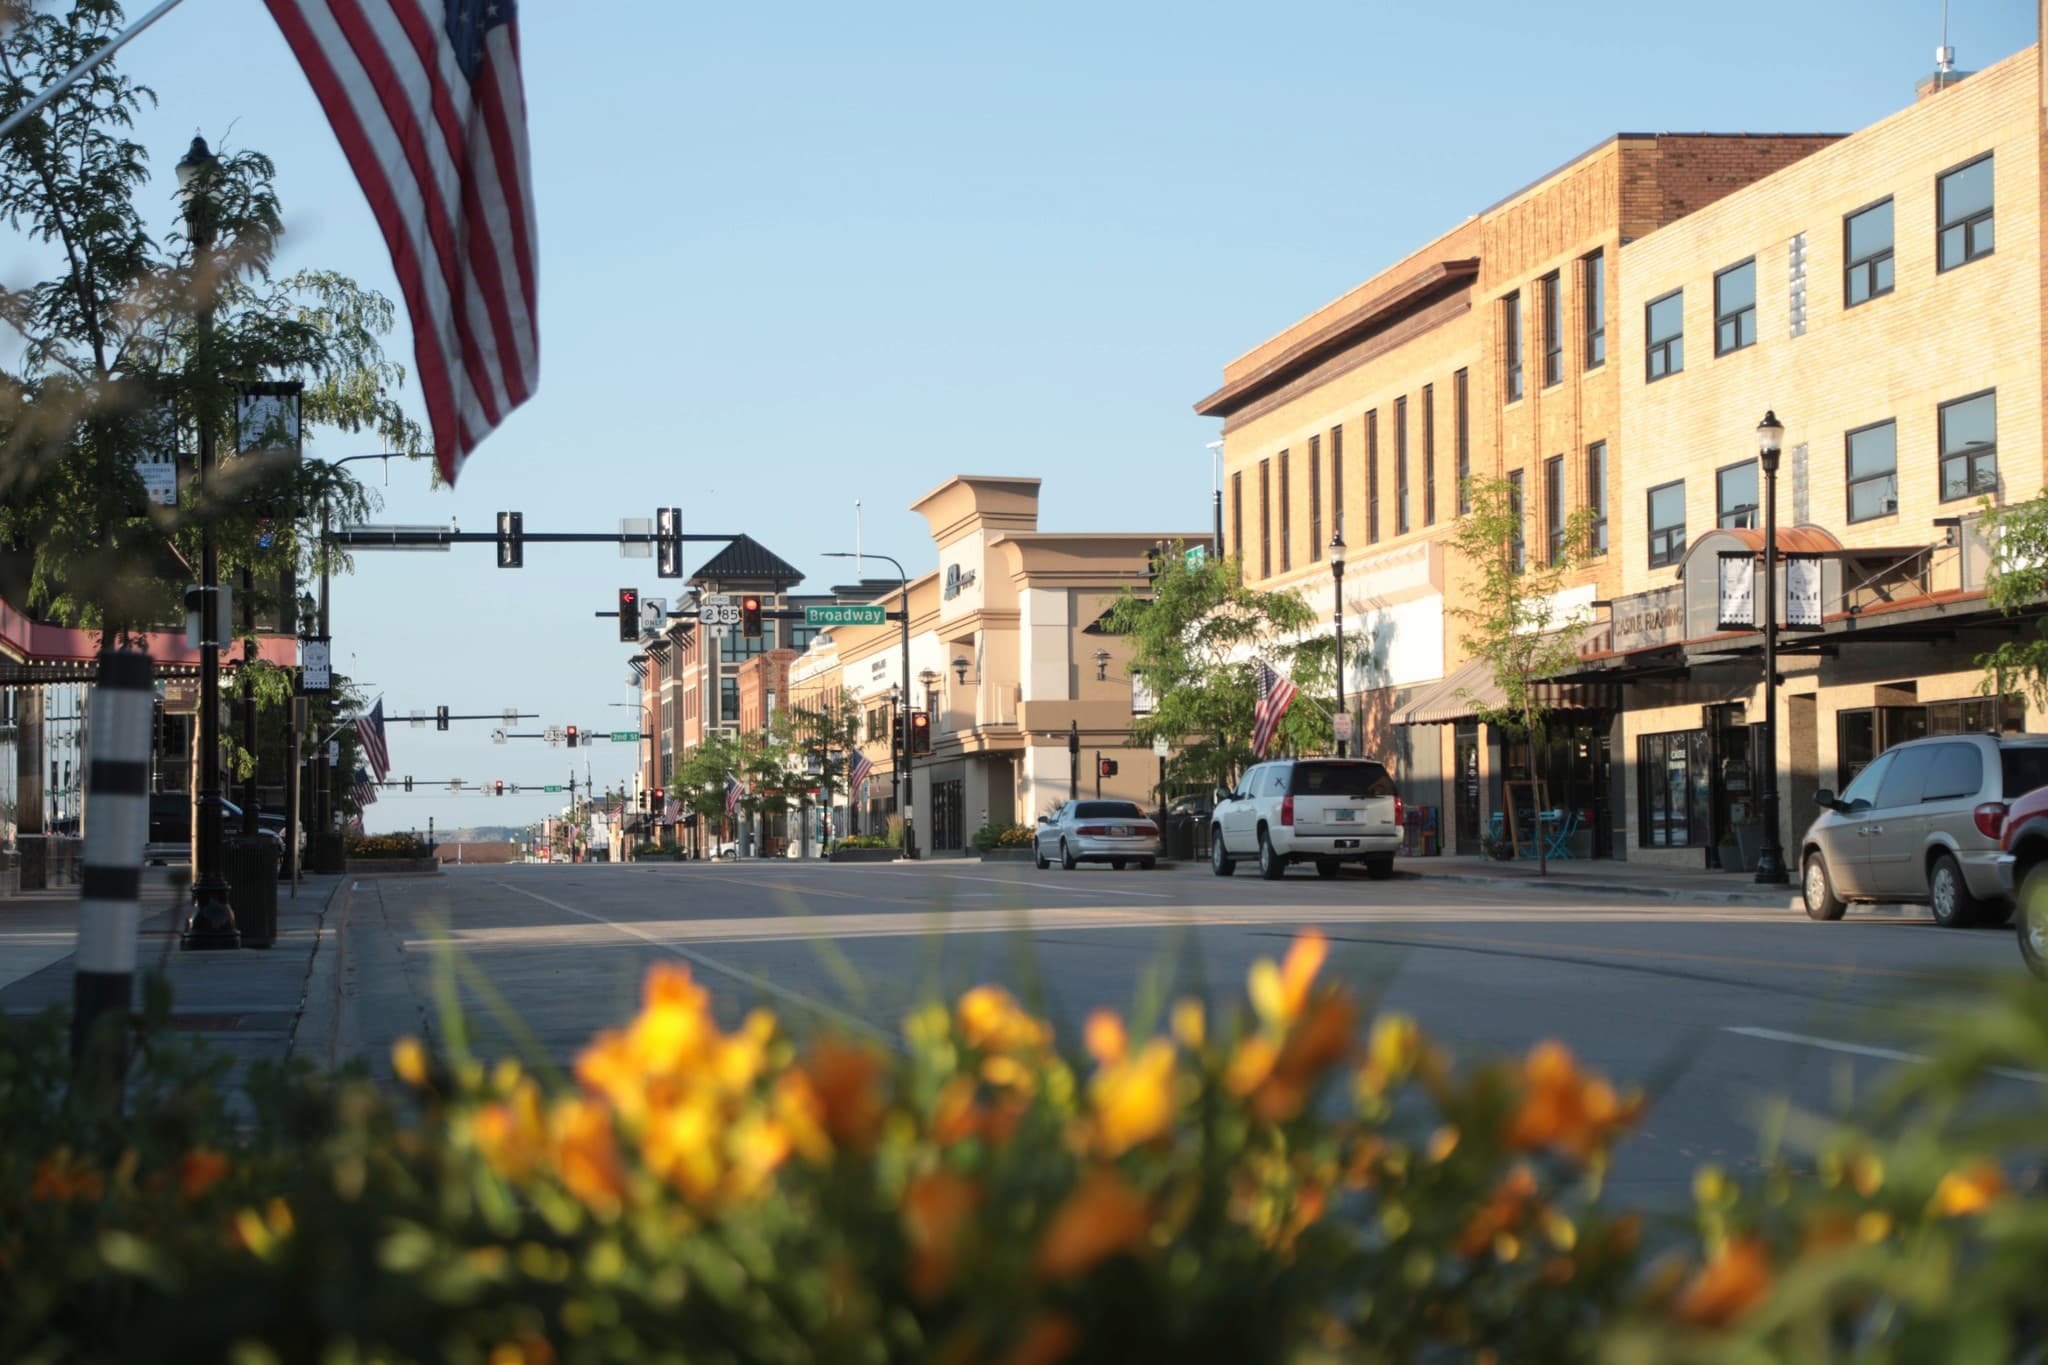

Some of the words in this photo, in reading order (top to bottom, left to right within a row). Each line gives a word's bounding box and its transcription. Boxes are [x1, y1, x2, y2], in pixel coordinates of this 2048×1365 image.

[706, 609, 713, 620] 2
[722, 609, 738, 620] 85
[810, 609, 881, 623] Broadway
[613, 733, 627, 741] 2nd
